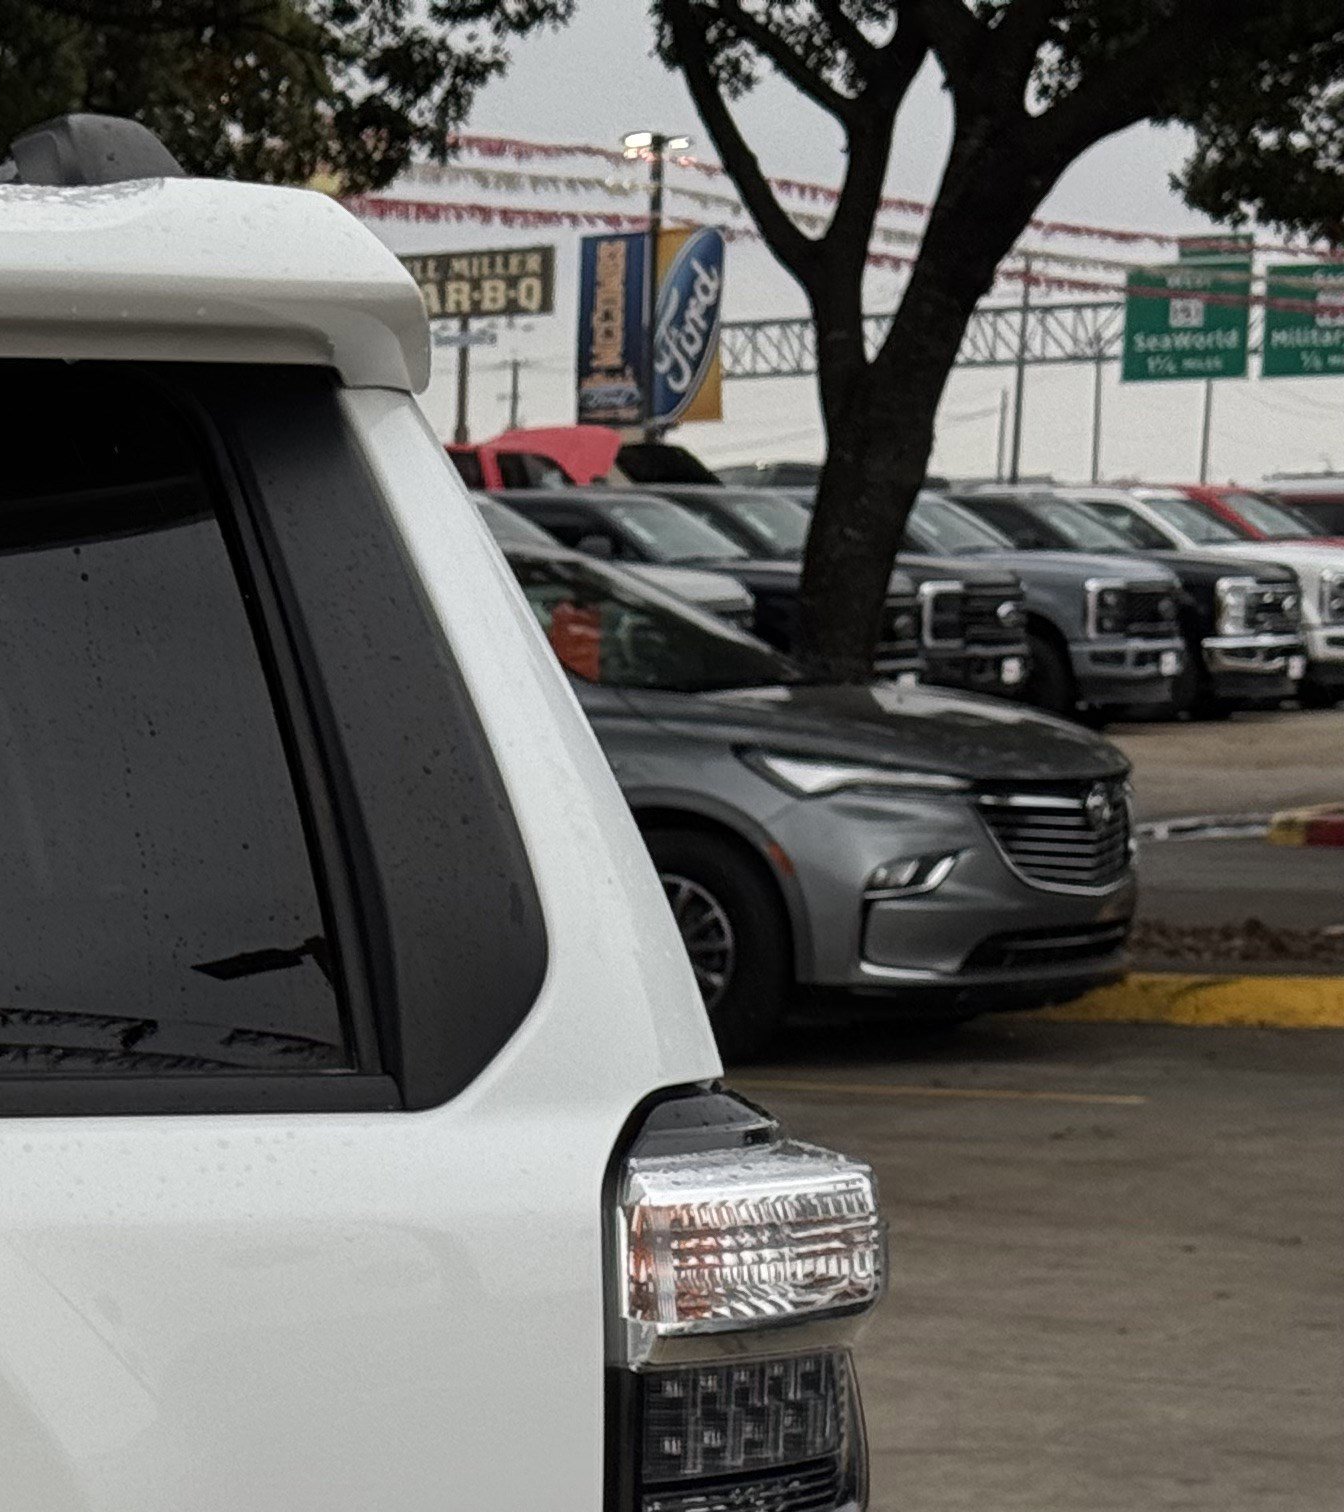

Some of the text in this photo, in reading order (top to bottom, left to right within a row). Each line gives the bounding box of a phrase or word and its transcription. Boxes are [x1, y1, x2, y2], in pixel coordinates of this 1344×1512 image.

[654, 258, 720, 394] Ford
[1133, 329, 1239, 353] SeaWorld
[1270, 328, 1344, 351] Militar
